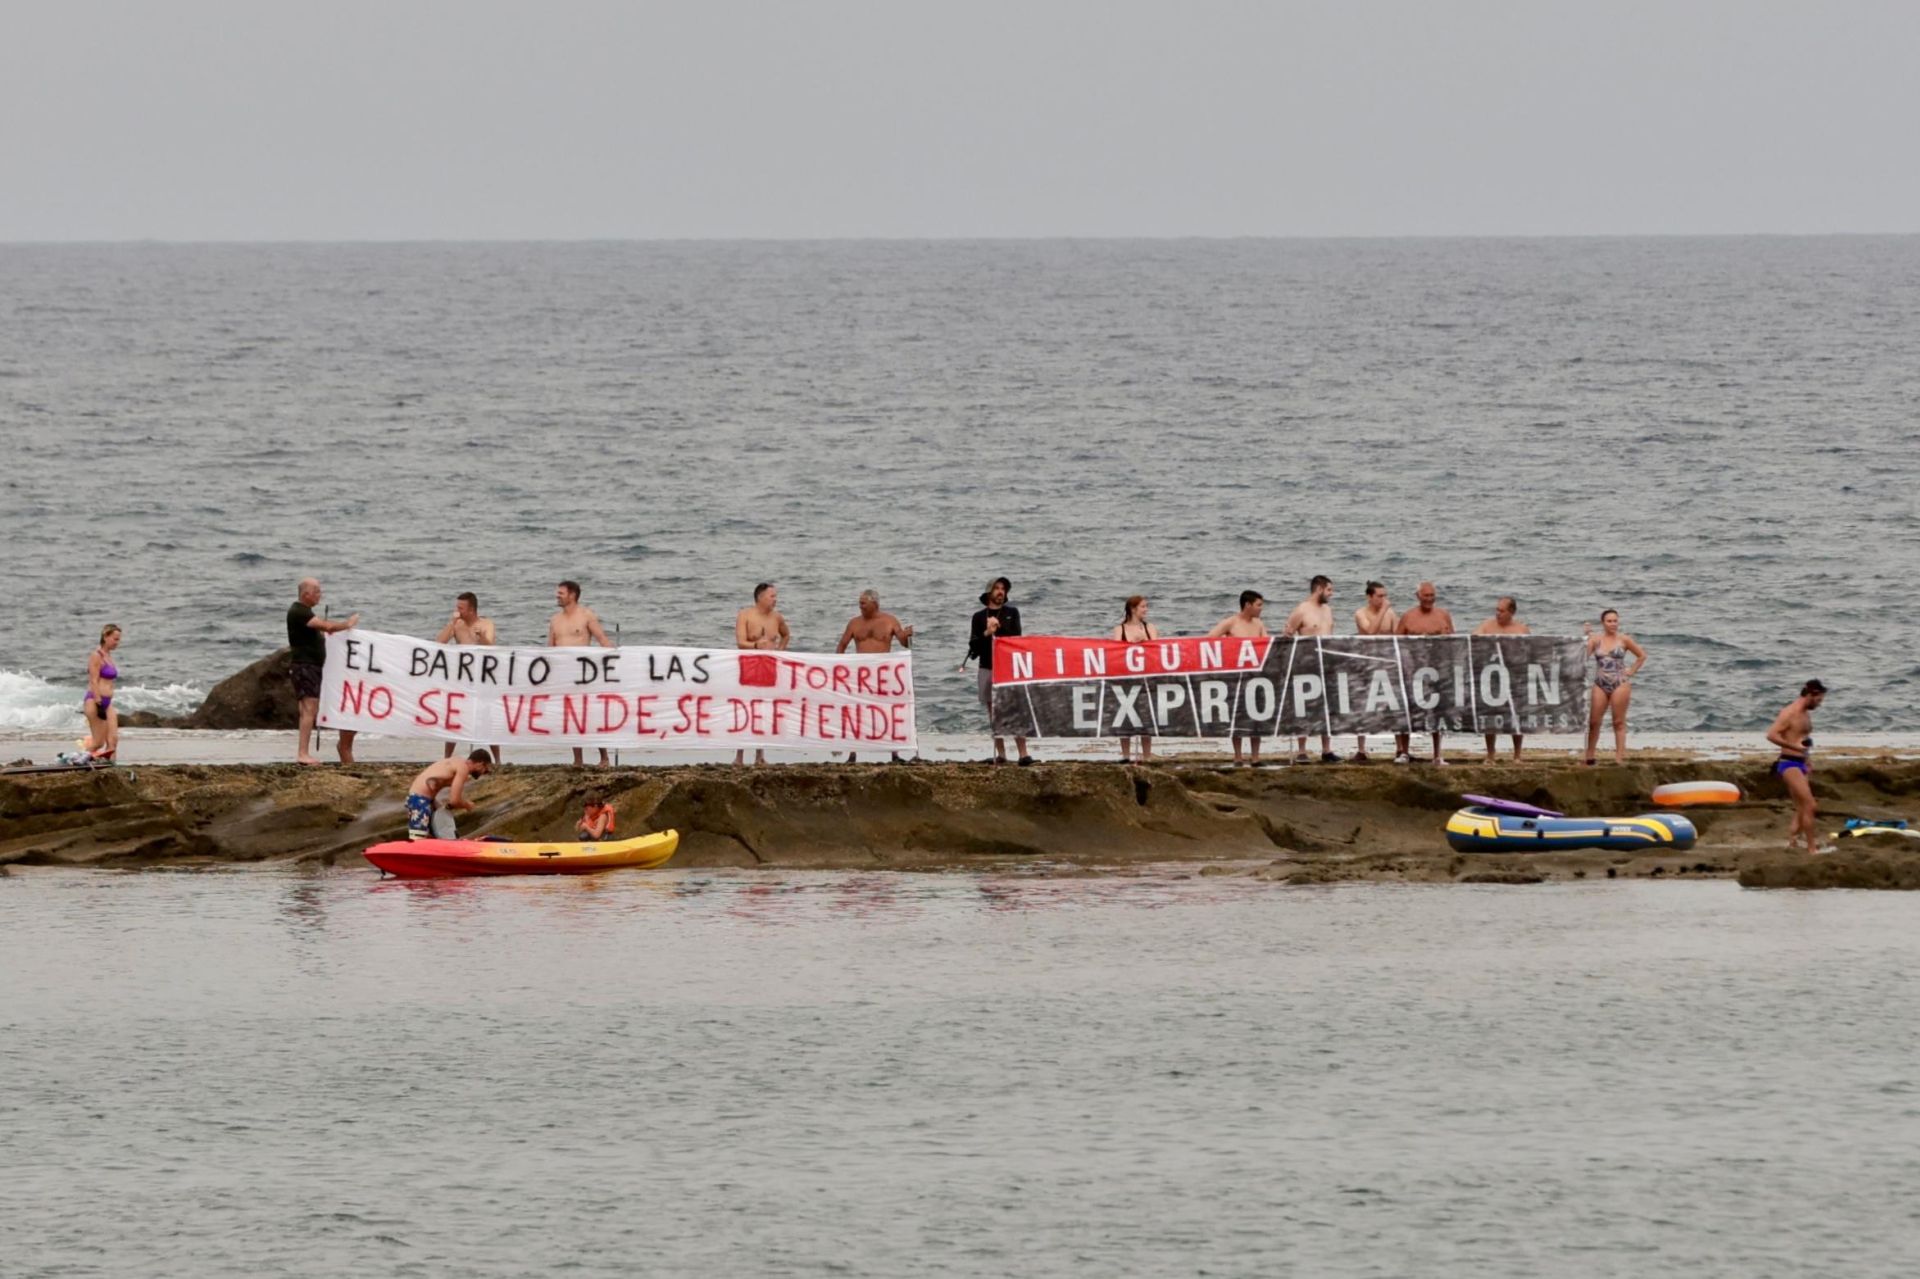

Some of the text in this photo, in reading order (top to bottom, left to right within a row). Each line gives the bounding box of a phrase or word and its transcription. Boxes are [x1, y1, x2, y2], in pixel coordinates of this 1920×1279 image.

[346, 639, 382, 673] EL
[409, 647, 551, 685] BARRIO
[574, 655, 621, 685] DE
[648, 653, 710, 683] LAS
[1012, 639, 1260, 679] NINGUNA
[340, 679, 394, 720] NO
[415, 689, 466, 730] SE
[727, 697, 907, 741] DEFIENDE
[1071, 653, 1561, 729] EXPROPIACIÓN
[1424, 716, 1463, 730] LAS
